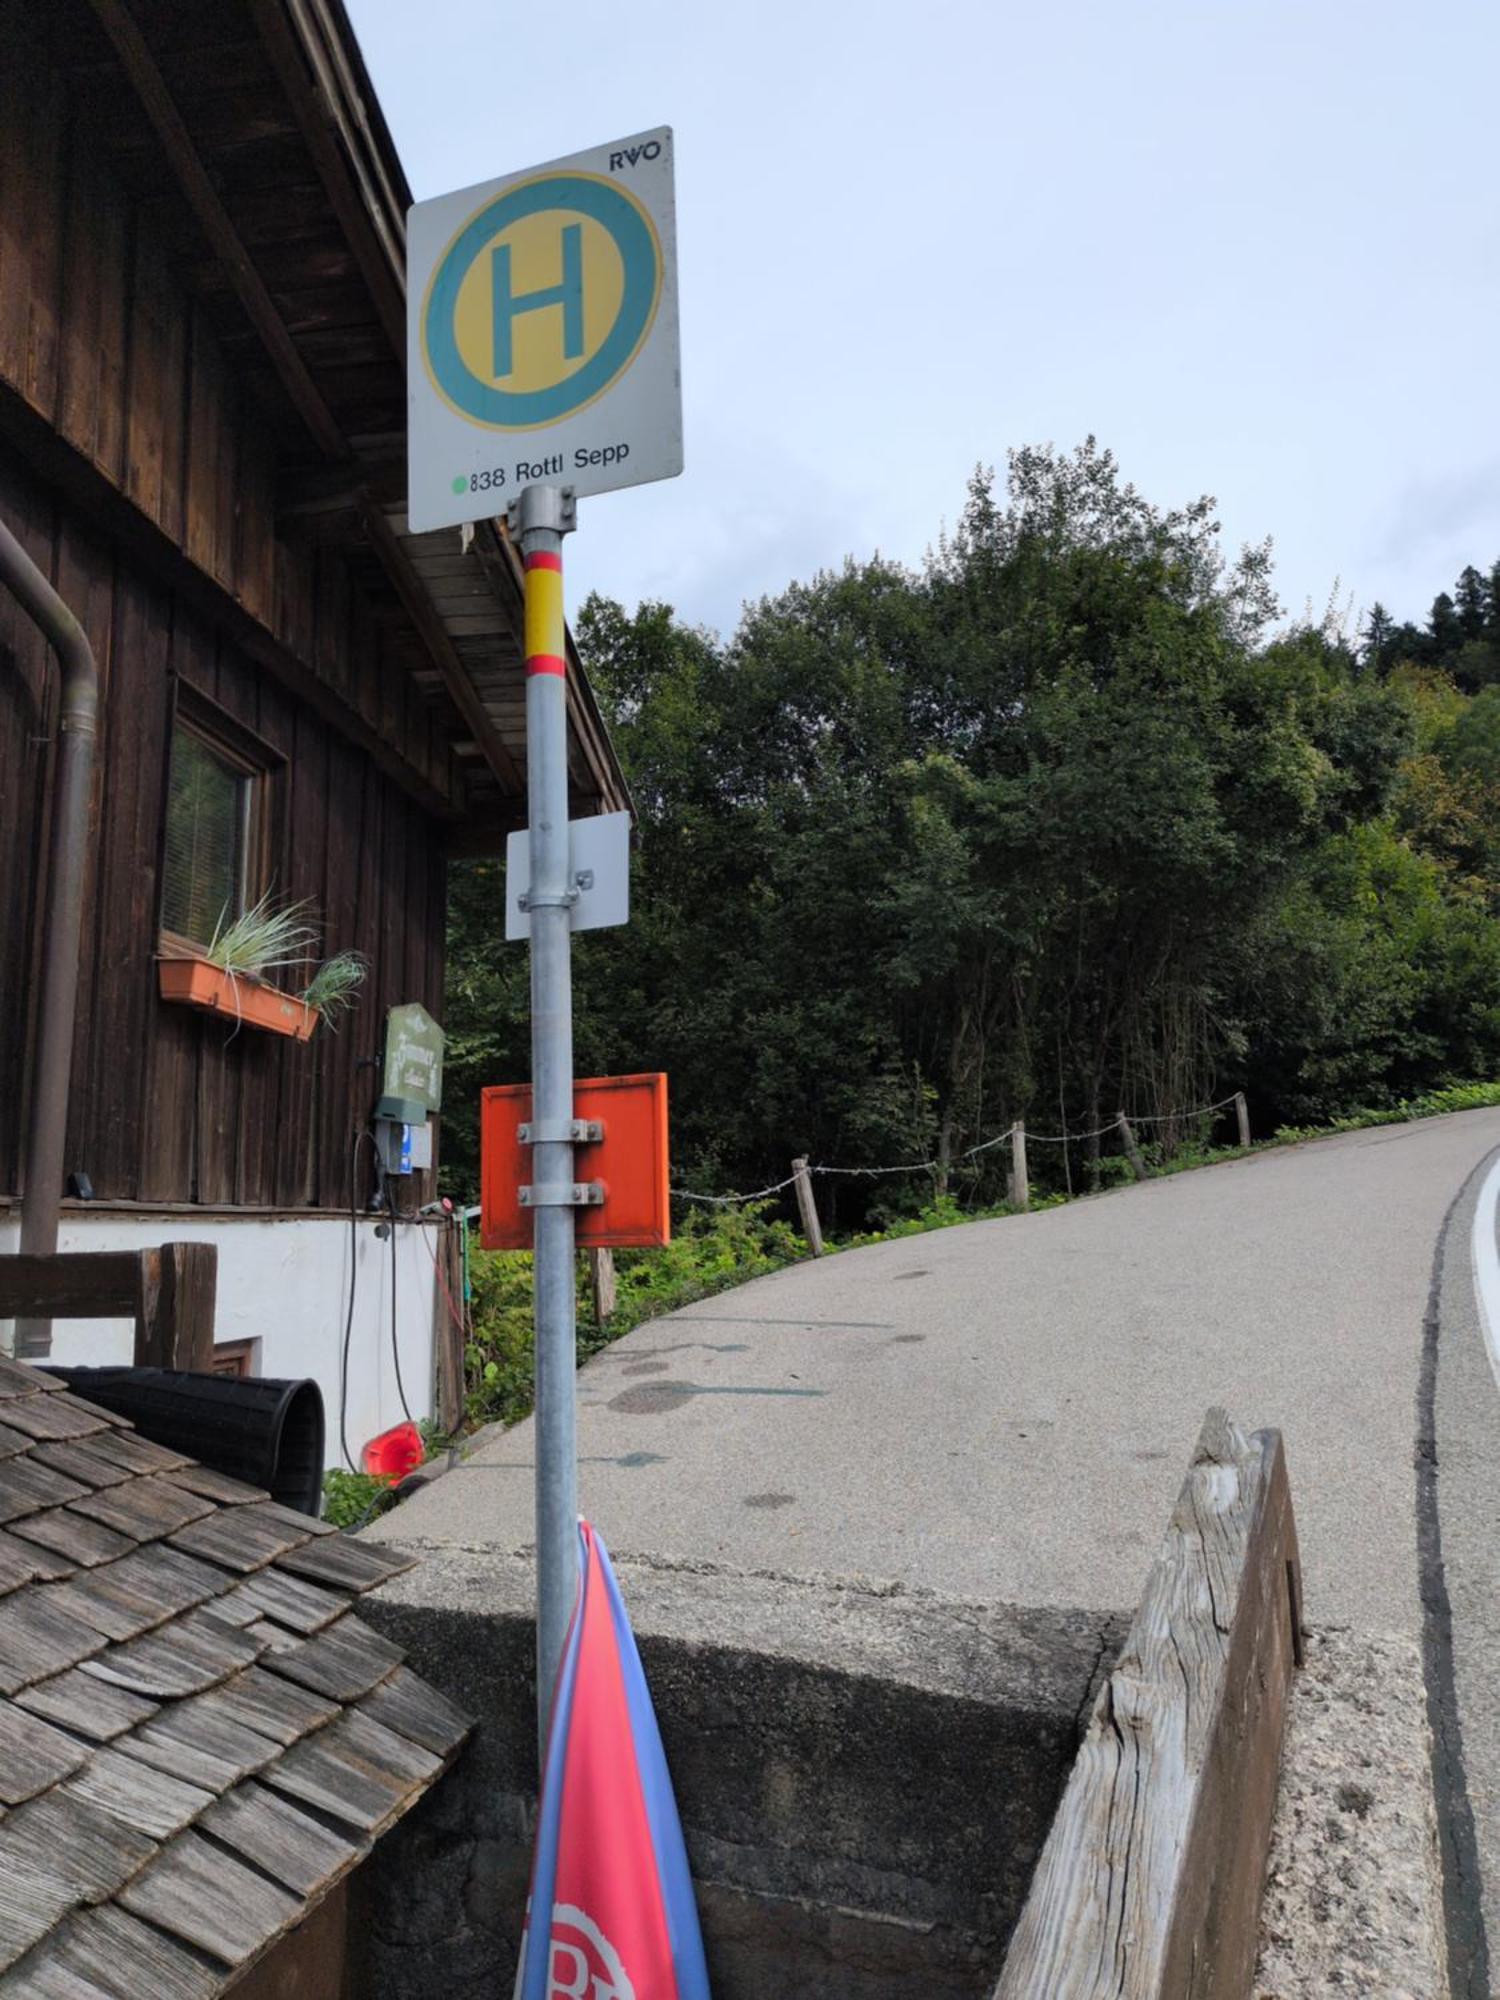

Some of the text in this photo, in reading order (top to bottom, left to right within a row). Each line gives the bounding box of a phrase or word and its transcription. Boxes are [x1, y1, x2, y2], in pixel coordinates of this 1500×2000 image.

[491, 222, 585, 379] H
[470, 443, 630, 492] 838 Rottl Sepp
